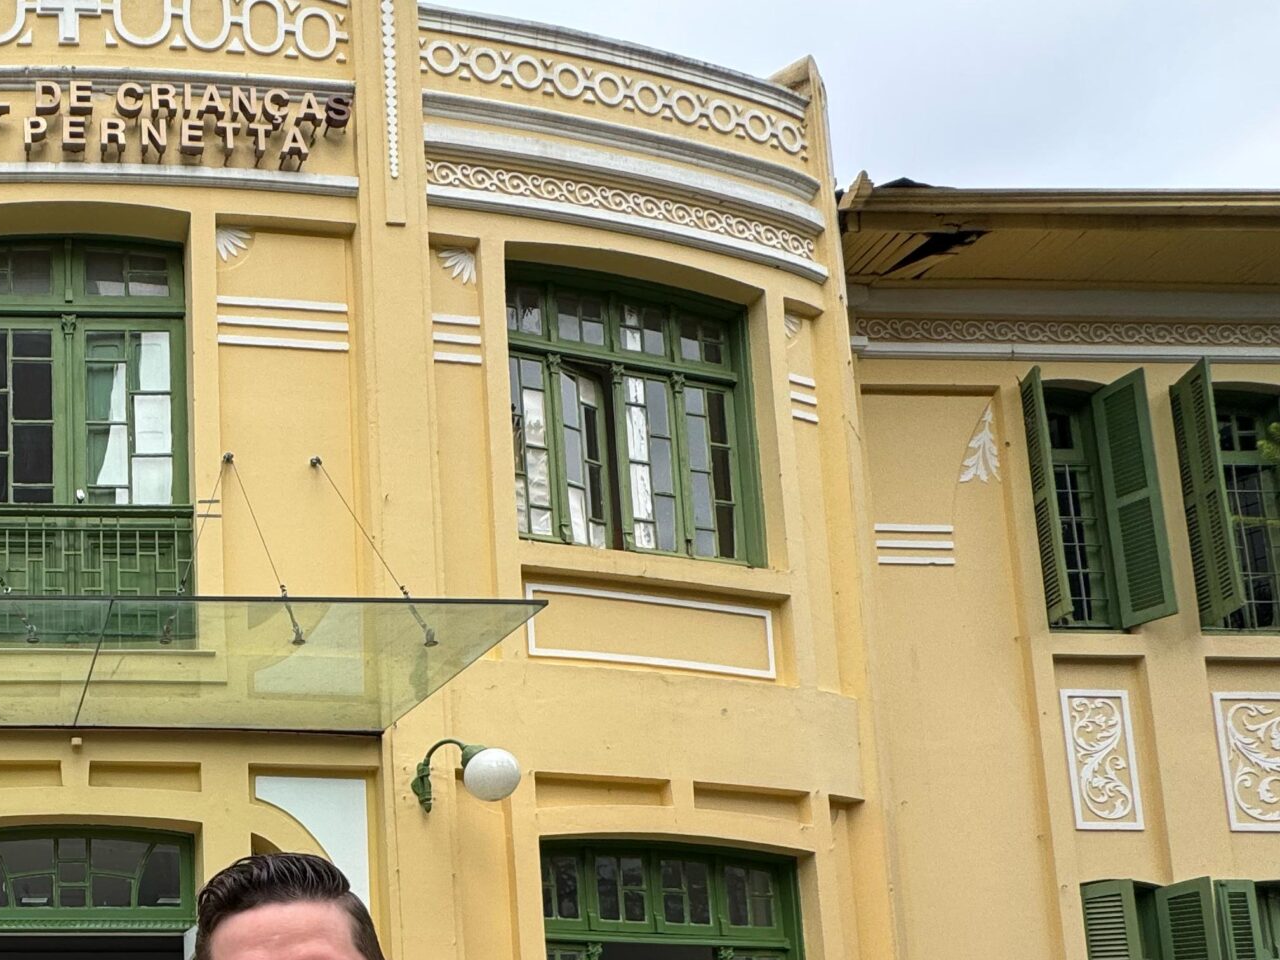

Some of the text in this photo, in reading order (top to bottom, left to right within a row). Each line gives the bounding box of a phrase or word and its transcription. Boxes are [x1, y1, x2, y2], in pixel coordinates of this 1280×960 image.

[35, 80, 93, 115] DE
[116, 82, 352, 128] CRIANÇAS
[24, 116, 309, 161] PERNETTA
